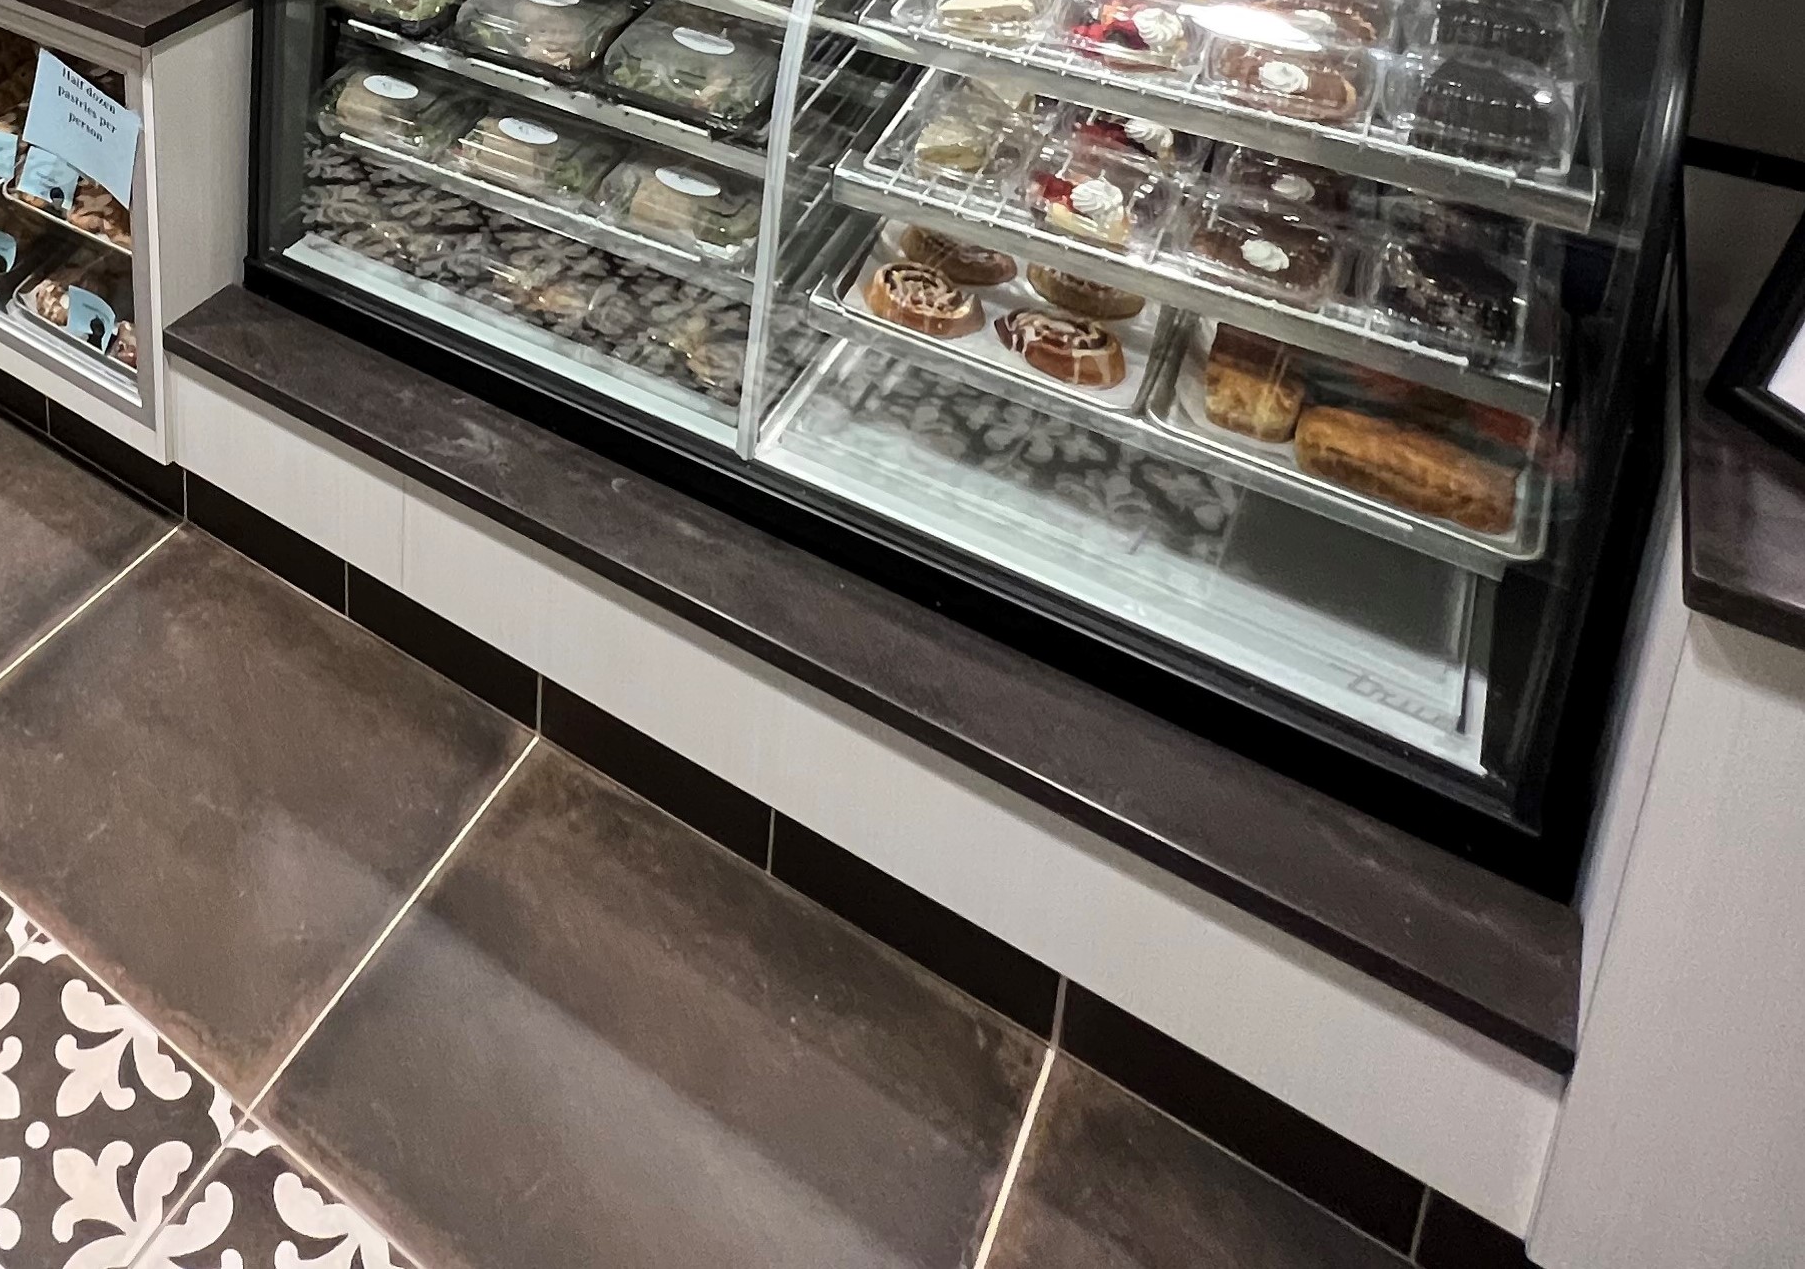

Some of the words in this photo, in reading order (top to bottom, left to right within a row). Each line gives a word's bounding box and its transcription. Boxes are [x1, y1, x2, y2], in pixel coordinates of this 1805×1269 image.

[57, 85, 98, 119] pastries
[99, 116, 117, 134] per
[62, 67, 85, 91] Half
[86, 87, 117, 115] dozen
[68, 112, 104, 143] person
